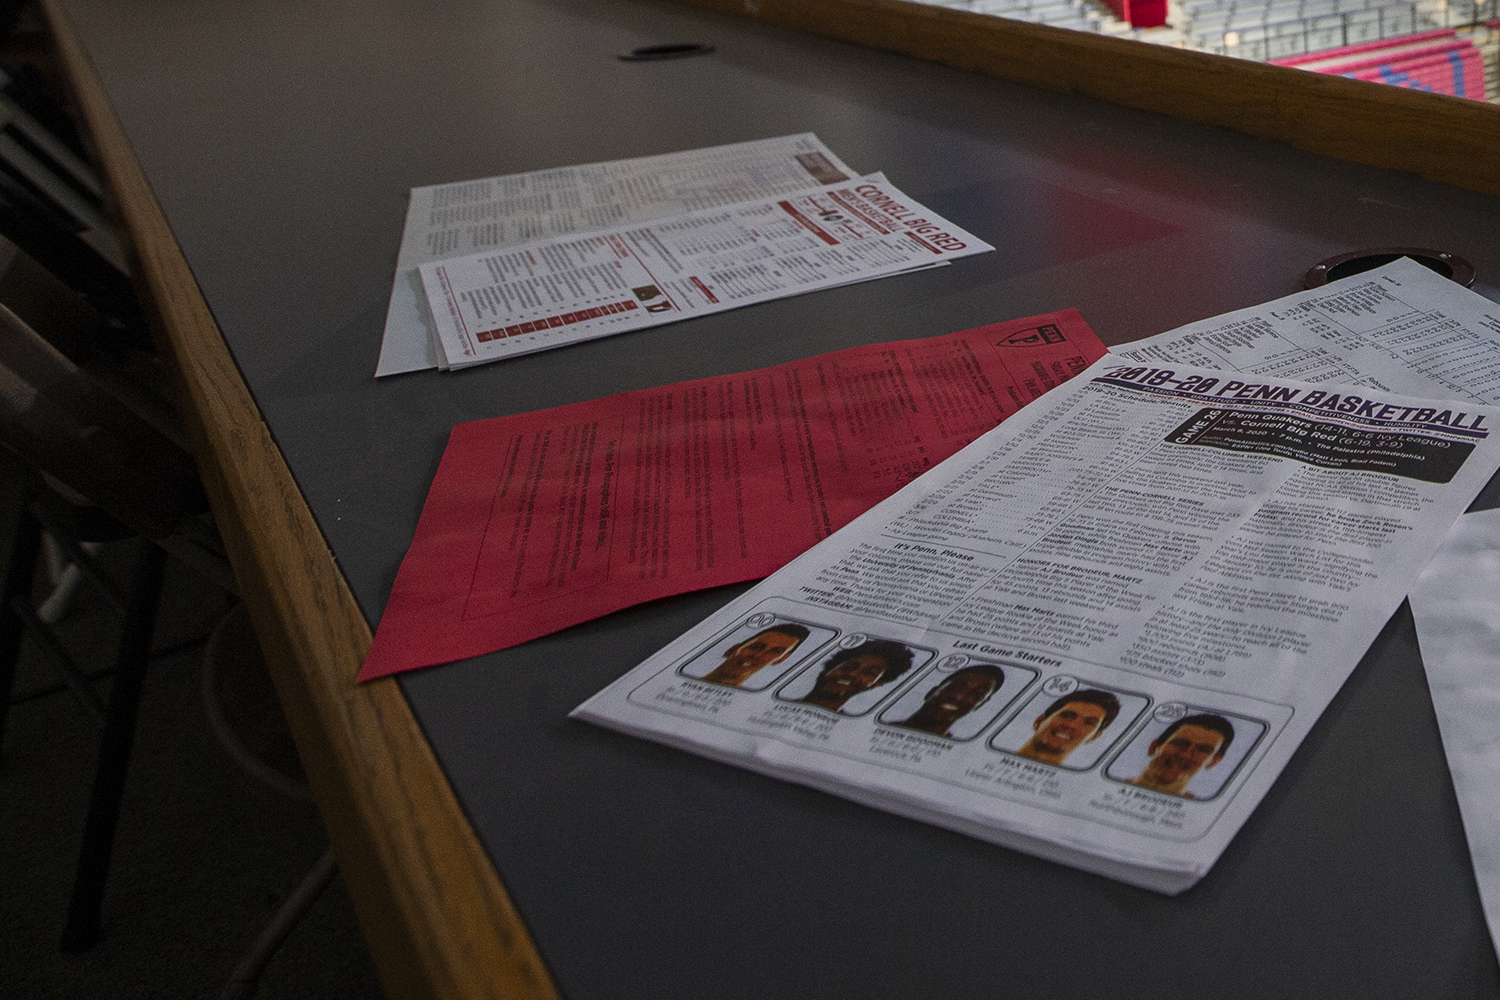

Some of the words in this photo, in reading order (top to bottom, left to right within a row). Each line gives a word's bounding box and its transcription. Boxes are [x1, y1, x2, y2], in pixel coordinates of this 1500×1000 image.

[855, 184, 914, 221] CORNELL
[905, 218, 940, 235] BIG
[929, 231, 967, 251] RED
[1143, 387, 1182, 396] PASSION
[1250, 399, 1275, 407] UNITY
[1286, 403, 1373, 423] COMPETITIVENESS
[1215, 380, 1301, 406] PENN
[1295, 390, 1488, 435] BASKETBALL
[1175, 420, 1209, 444] GAME
[1211, 424, 1238, 433] March
[1244, 428, 1269, 437] 2020
[1332, 446, 1365, 454] Palestra
[1366, 450, 1426, 461] (Philadelphia)
[1229, 411, 1259, 420] Penn
[1262, 414, 1312, 428] Quakers
[1376, 434, 1396, 442] Ivy
[1398, 435, 1451, 449] League)
[1240, 420, 1286, 429] Cornell
[1286, 425, 1308, 436] Big
[1310, 431, 1338, 441] Red
[1246, 454, 1283, 462] WEEKEND
[1258, 508, 1290, 517] program
[940, 550, 974, 561] Please
[1016, 558, 1051, 568] HONORS
[1112, 574, 1143, 584] MARTZ
[952, 640, 978, 650] Last
[980, 645, 1013, 656] Game
[1015, 651, 1062, 667] Starters
